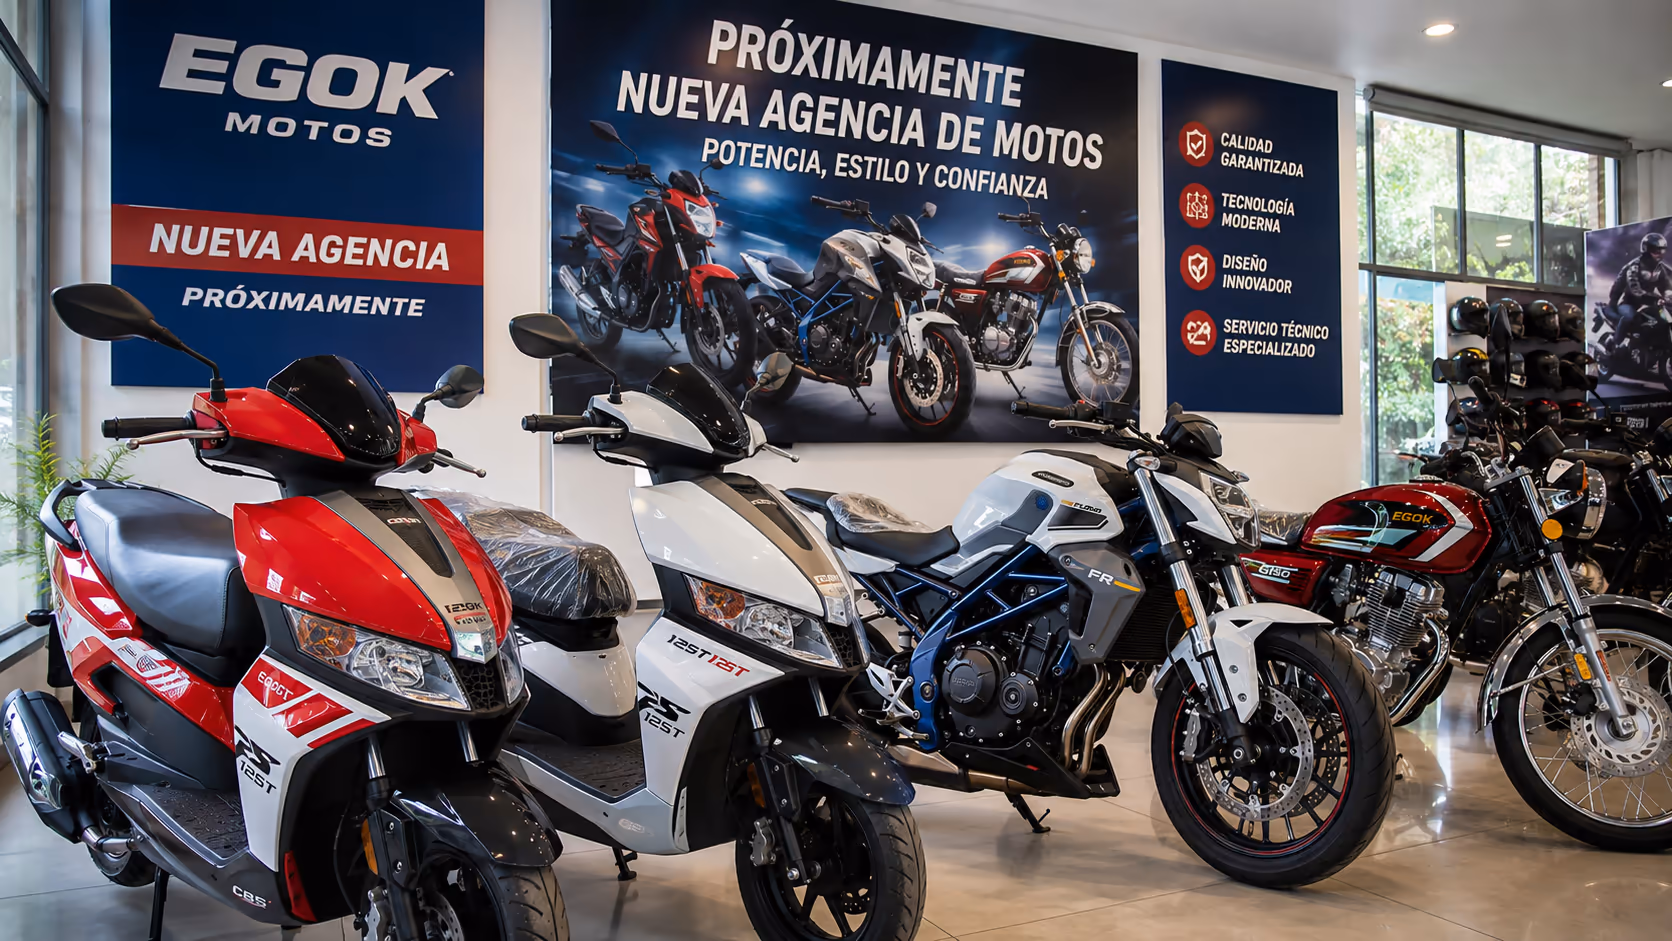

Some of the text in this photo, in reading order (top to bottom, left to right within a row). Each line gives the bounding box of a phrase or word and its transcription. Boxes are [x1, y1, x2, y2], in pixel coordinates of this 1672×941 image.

[707, 18, 1025, 108] PRÓXIMAMENTE
[160, 33, 450, 120] EGOK
[225, 112, 392, 148] MOTOS
[616, 70, 1104, 170] NUEVA AGENCIA DE MOTOS
[1220, 132, 1273, 154] CALIDAD
[701, 137, 1049, 200] POTENCIA, ESTILO Y CONFIANZA
[1220, 151, 1304, 178] GARANTIZADA
[1221, 192, 1295, 216] TECNOLOGÍA
[1221, 212, 1281, 233] MODERNA
[149, 223, 450, 271] NUEVA AGENCIA
[1222, 254, 1268, 273] DISEÑO
[1222, 274, 1293, 294] INNOVADOR
[182, 285, 426, 317] PRÓXIMAMENTE
[1223, 319, 1330, 340] SERVICIO TÉCNICO
[1223, 339, 1316, 358] ESPECIALIZADO
[1392, 511, 1434, 524] EGOK
[1087, 569, 1114, 585] FR
